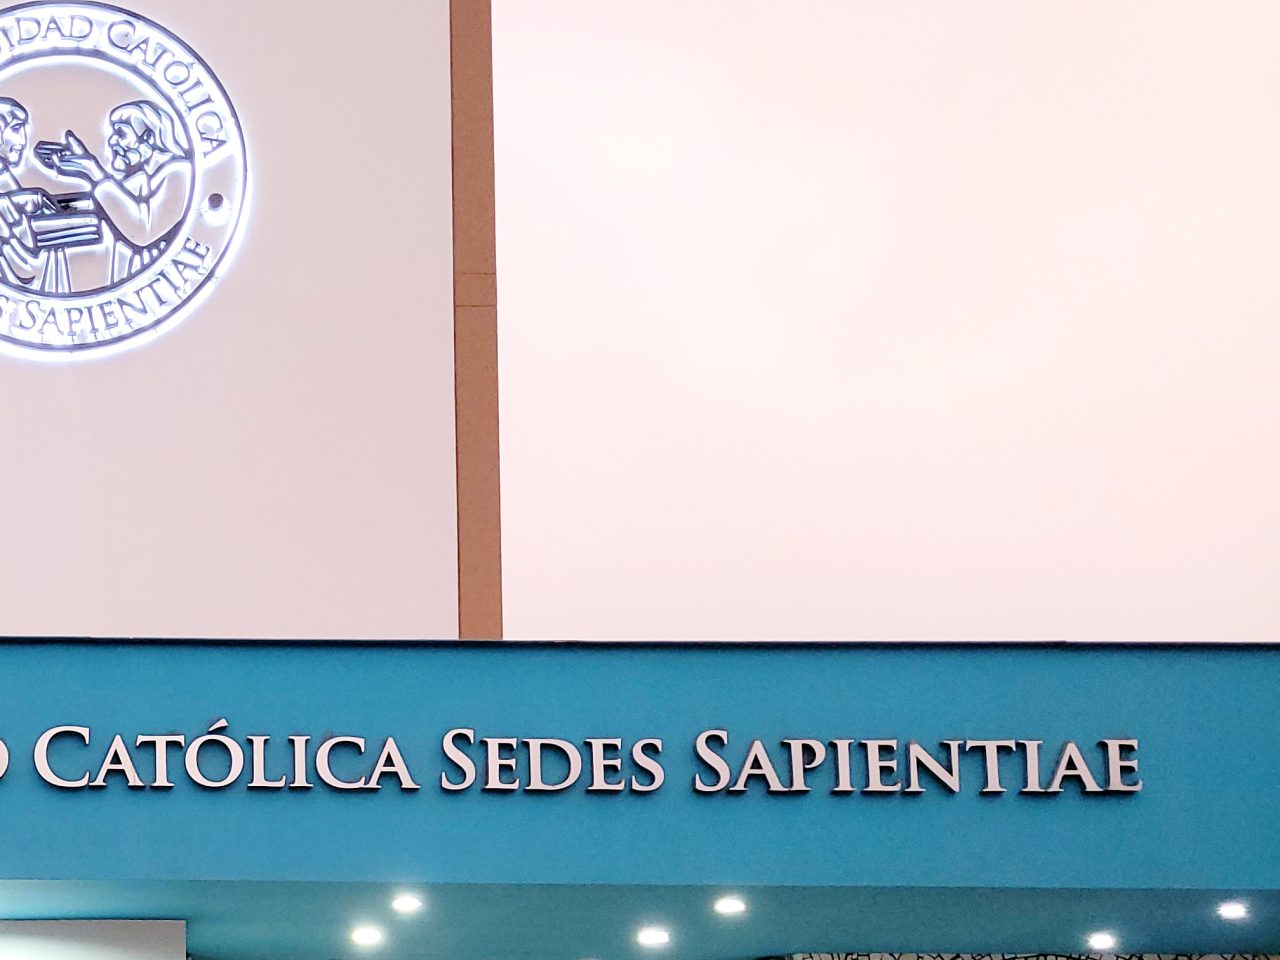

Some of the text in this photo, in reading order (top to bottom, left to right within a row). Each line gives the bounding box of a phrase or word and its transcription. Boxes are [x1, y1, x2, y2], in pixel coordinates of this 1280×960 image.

[18, 237, 211, 337] SAPIENTIAE
[33, 717, 420, 791] CATÓLICA
[440, 726, 666, 794] SEDES
[693, 728, 1145, 796] SAPIENTIAE
